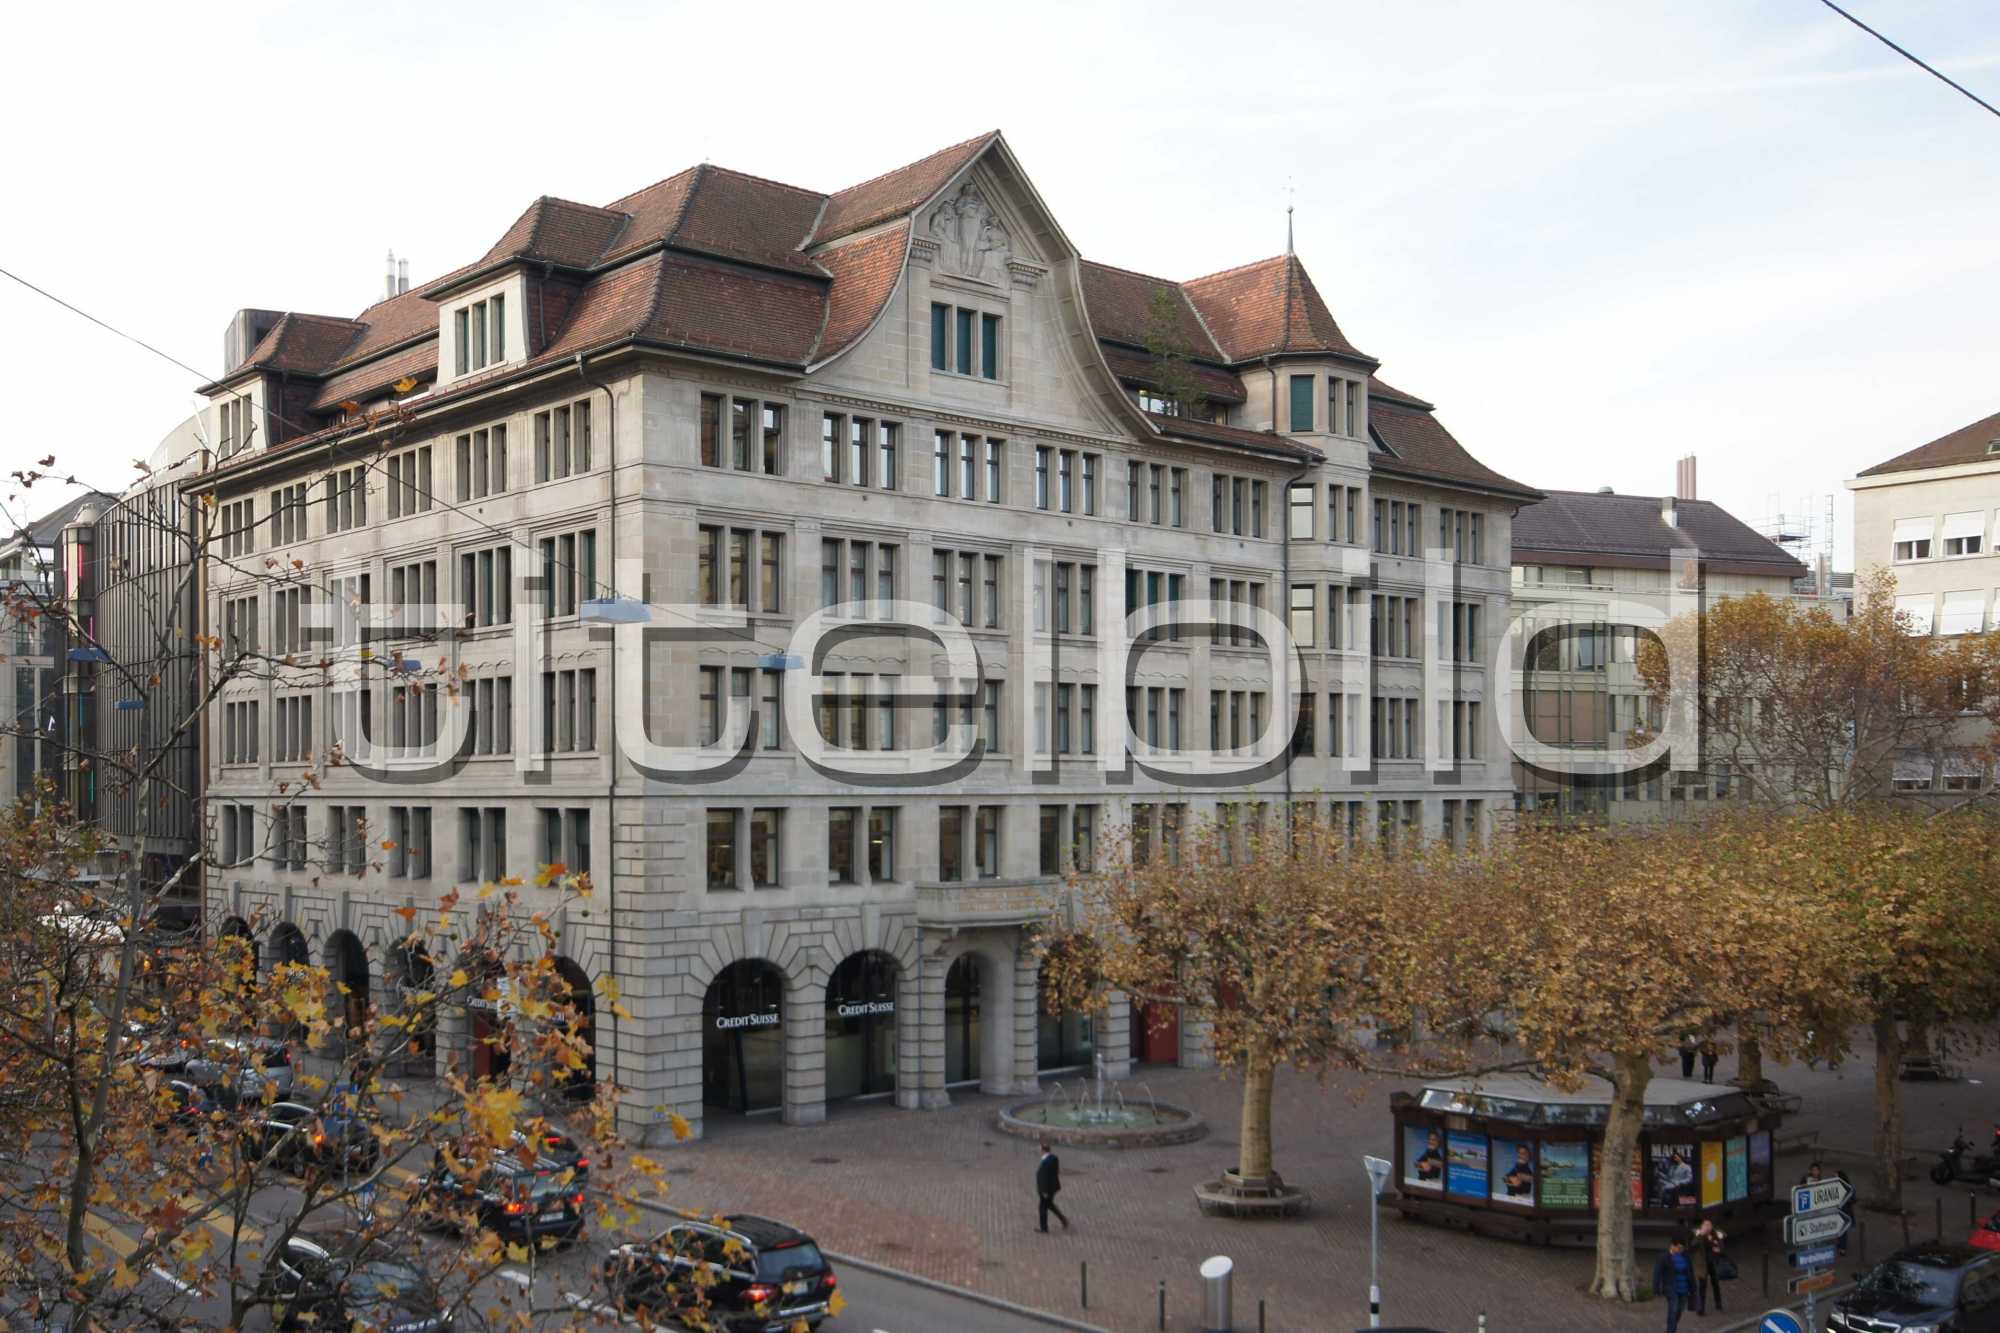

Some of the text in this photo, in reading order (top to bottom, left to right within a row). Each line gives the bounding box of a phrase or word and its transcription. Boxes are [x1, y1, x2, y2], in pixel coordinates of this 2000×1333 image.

[837, 1001, 895, 1017] CREDIT SUISSE
[716, 1013, 779, 1029] CREDIT SUISSE
[1651, 1143, 1694, 1158] MACHT
[1813, 1186, 1840, 1205] URANIA
